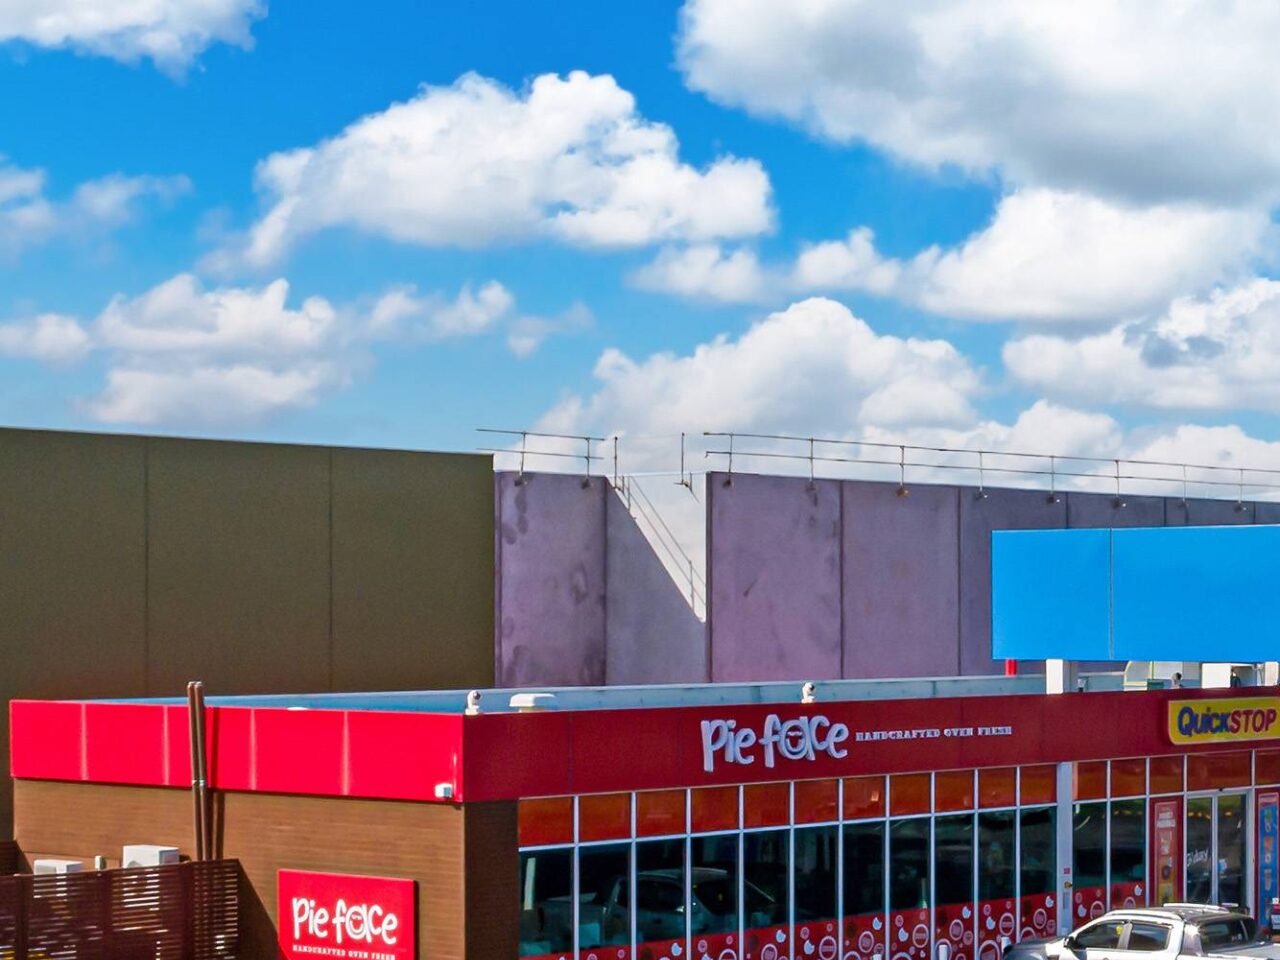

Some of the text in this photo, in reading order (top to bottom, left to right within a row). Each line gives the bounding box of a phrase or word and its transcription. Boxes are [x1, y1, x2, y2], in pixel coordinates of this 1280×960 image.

[700, 713, 849, 773] Pie face
[855, 726, 1012, 742] HANDCRAFTED OVEN FRESH
[292, 897, 398, 945] Pie face
